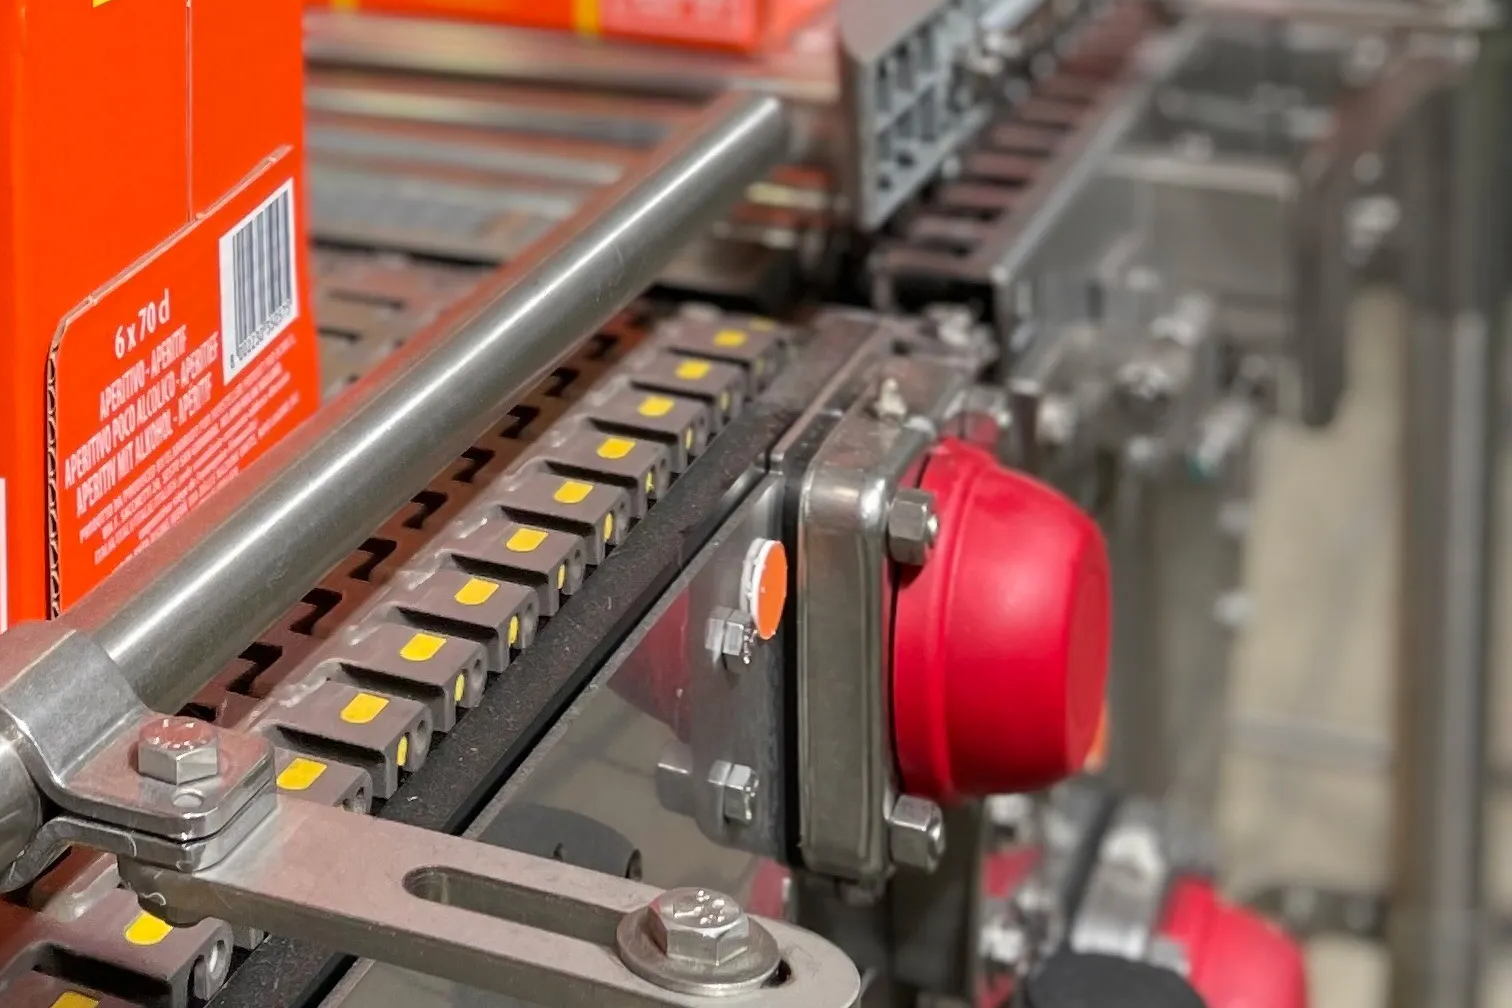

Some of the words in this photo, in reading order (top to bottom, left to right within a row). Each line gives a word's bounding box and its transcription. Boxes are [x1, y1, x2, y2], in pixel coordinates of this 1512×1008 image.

[114, 325, 126, 360] 6
[127, 323, 137, 353] x
[137, 301, 156, 342] 70
